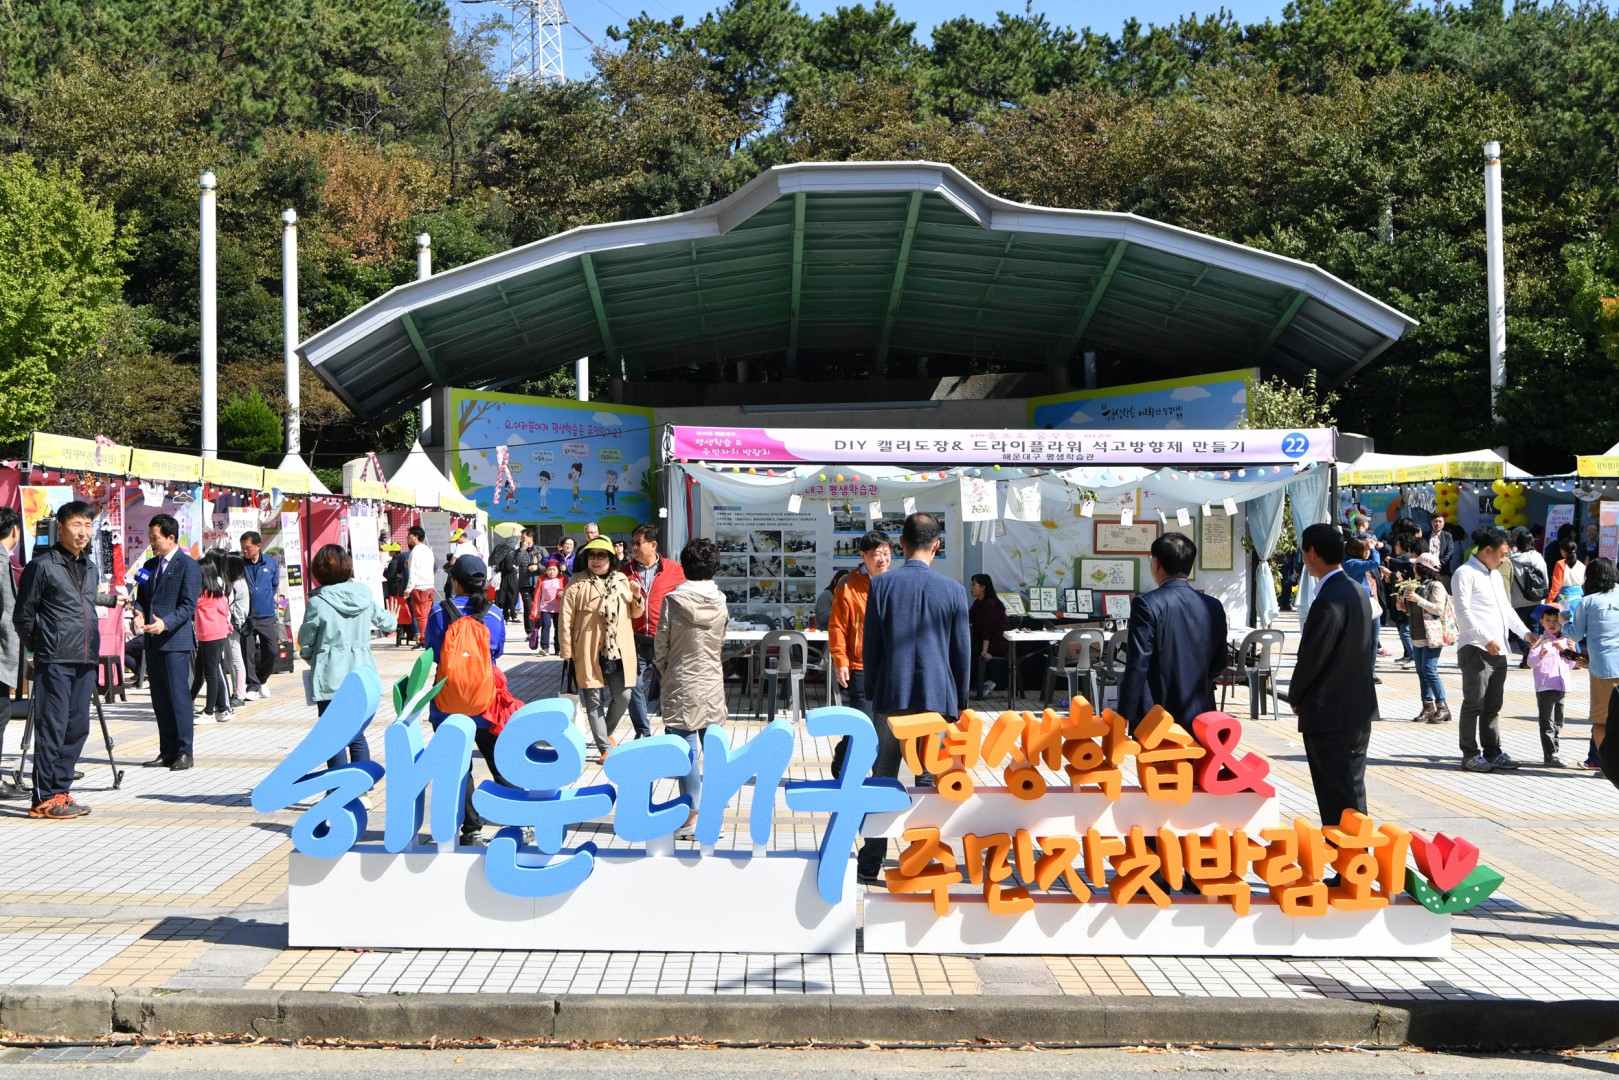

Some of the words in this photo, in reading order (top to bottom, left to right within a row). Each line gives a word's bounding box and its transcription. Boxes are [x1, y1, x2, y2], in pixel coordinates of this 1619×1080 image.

[552, 422, 584, 436] 평생학습은
[1033, 431, 1077, 440] 꿈꾸는
[695, 437, 732, 447] 평생학습
[834, 440, 868, 451] DIY
[877, 440, 964, 452] 캘리도장&
[972, 440, 1082, 453] 드라이플라워
[1092, 440, 1183, 453] 석고방향제
[1193, 440, 1246, 453] 만들기
[1285, 437, 1305, 453] 22
[702, 447, 739, 456] 주민자치
[742, 447, 771, 457] 박람회
[1002, 453, 1041, 461] 해운대구
[1046, 453, 1094, 461] 평생학습관
[829, 483, 878, 496] 평생학습관
[250, 671, 912, 904] 해운대구
[885, 808, 1413, 917] 주민자치박람회
